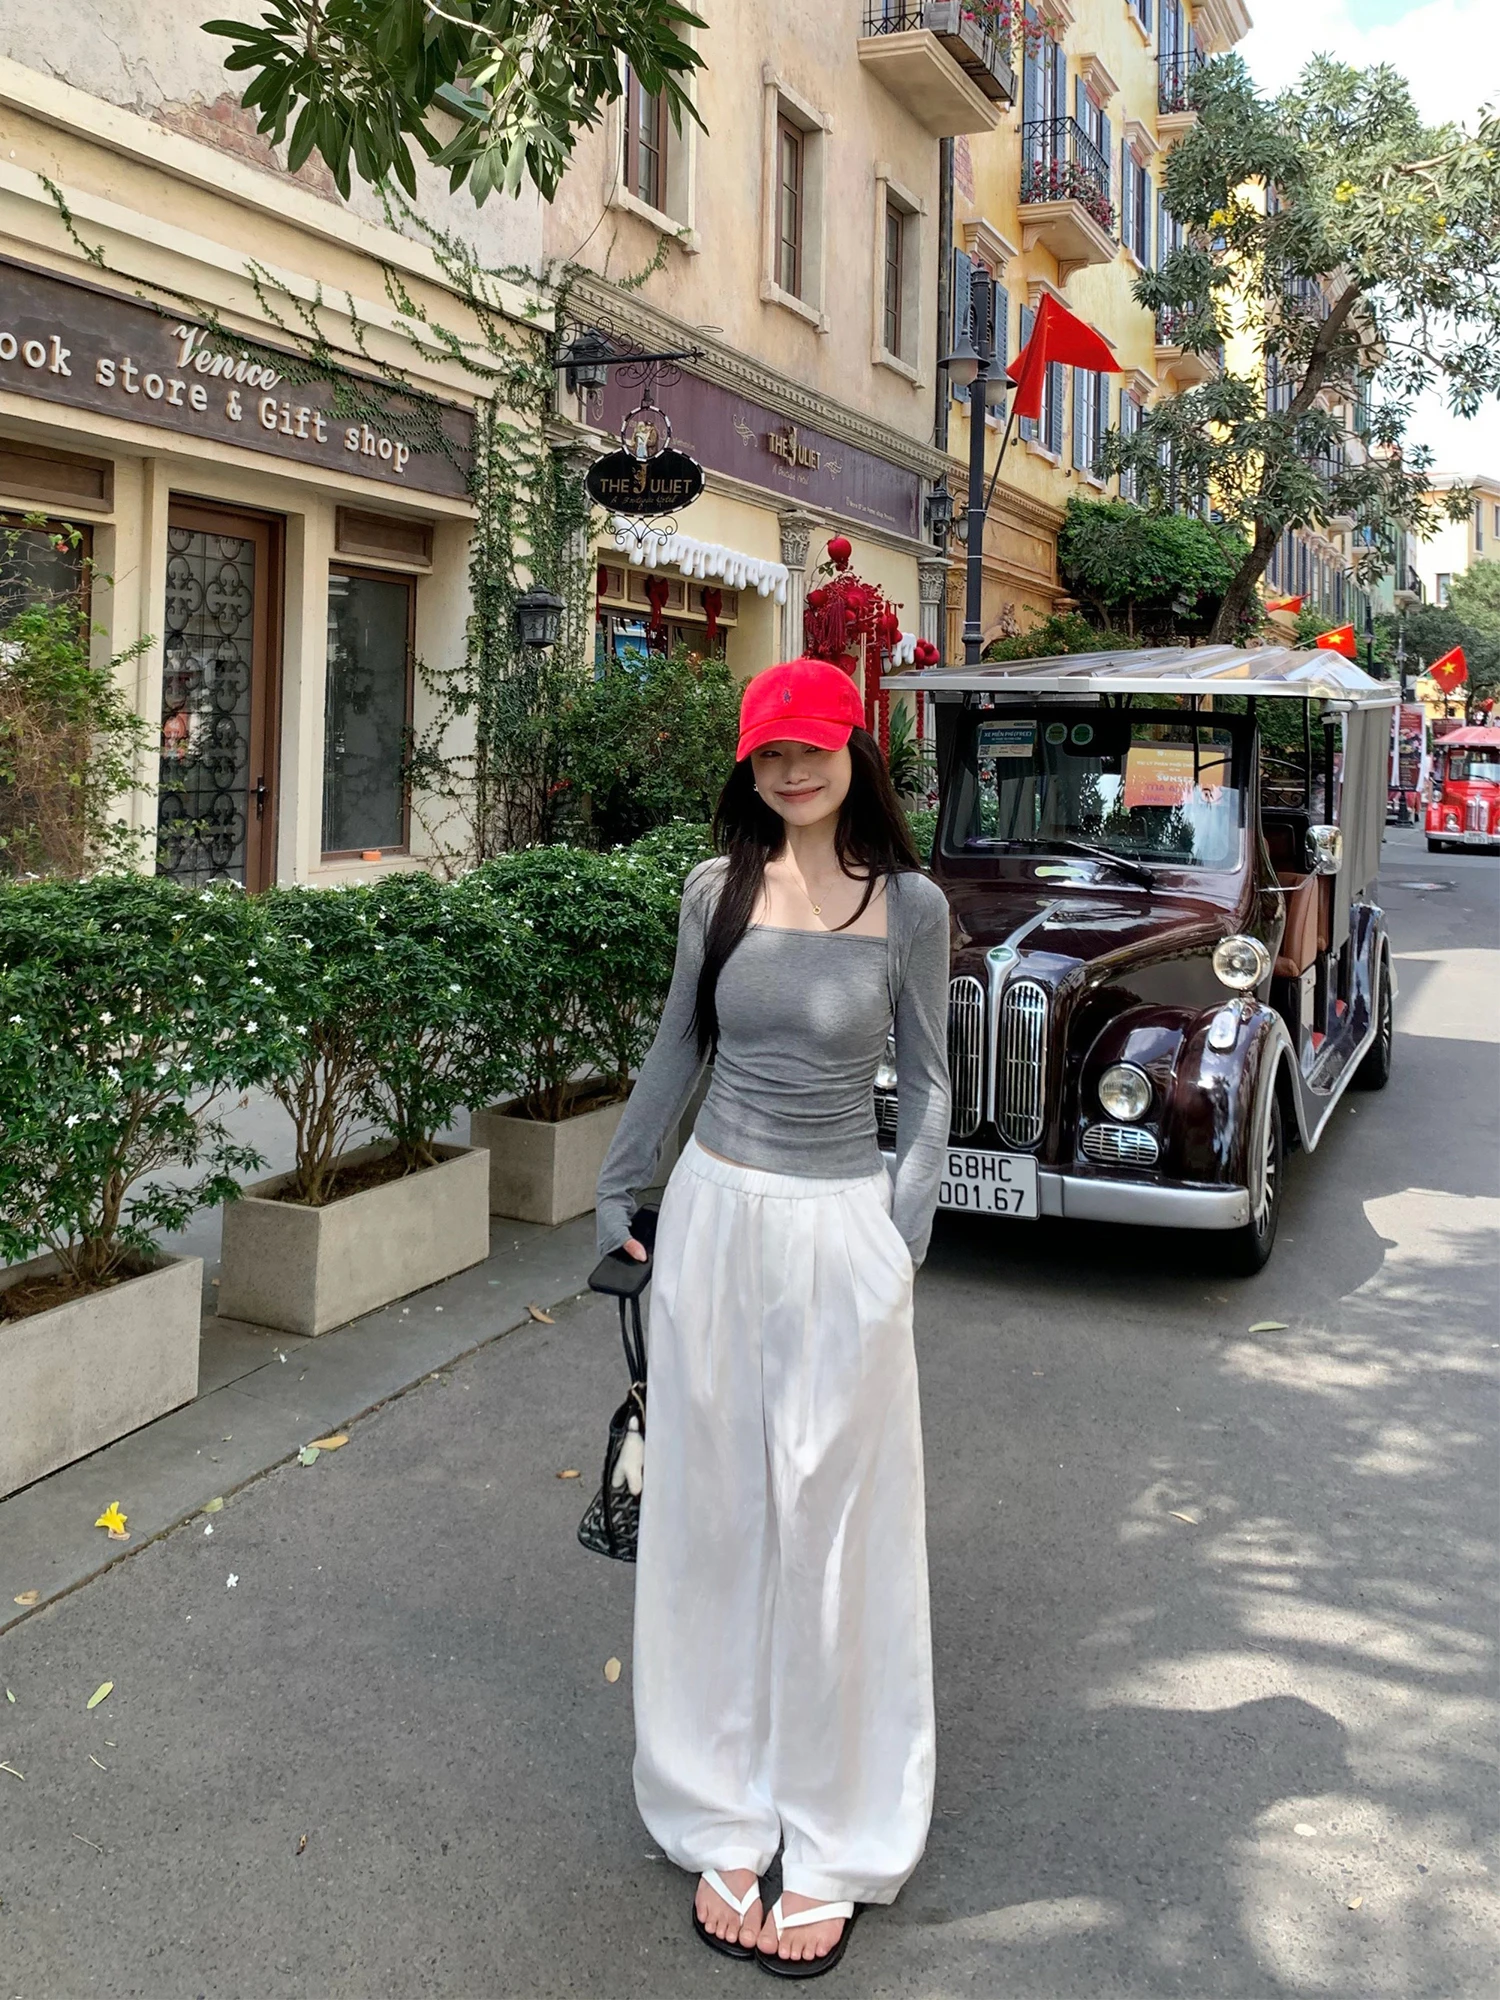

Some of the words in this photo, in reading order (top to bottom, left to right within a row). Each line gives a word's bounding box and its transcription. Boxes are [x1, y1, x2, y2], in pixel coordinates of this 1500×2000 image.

[170, 324, 284, 391] Venice
[95, 357, 208, 411] store
[226, 390, 242, 421] &
[258, 397, 328, 443] Gift
[344, 424, 410, 473] shop
[767, 432, 788, 459] THE
[600, 478, 630, 494] THE
[632, 462, 693, 495] JULIET
[949, 1153, 1012, 1182] 68HC
[939, 1181, 1025, 1213] 001.67
